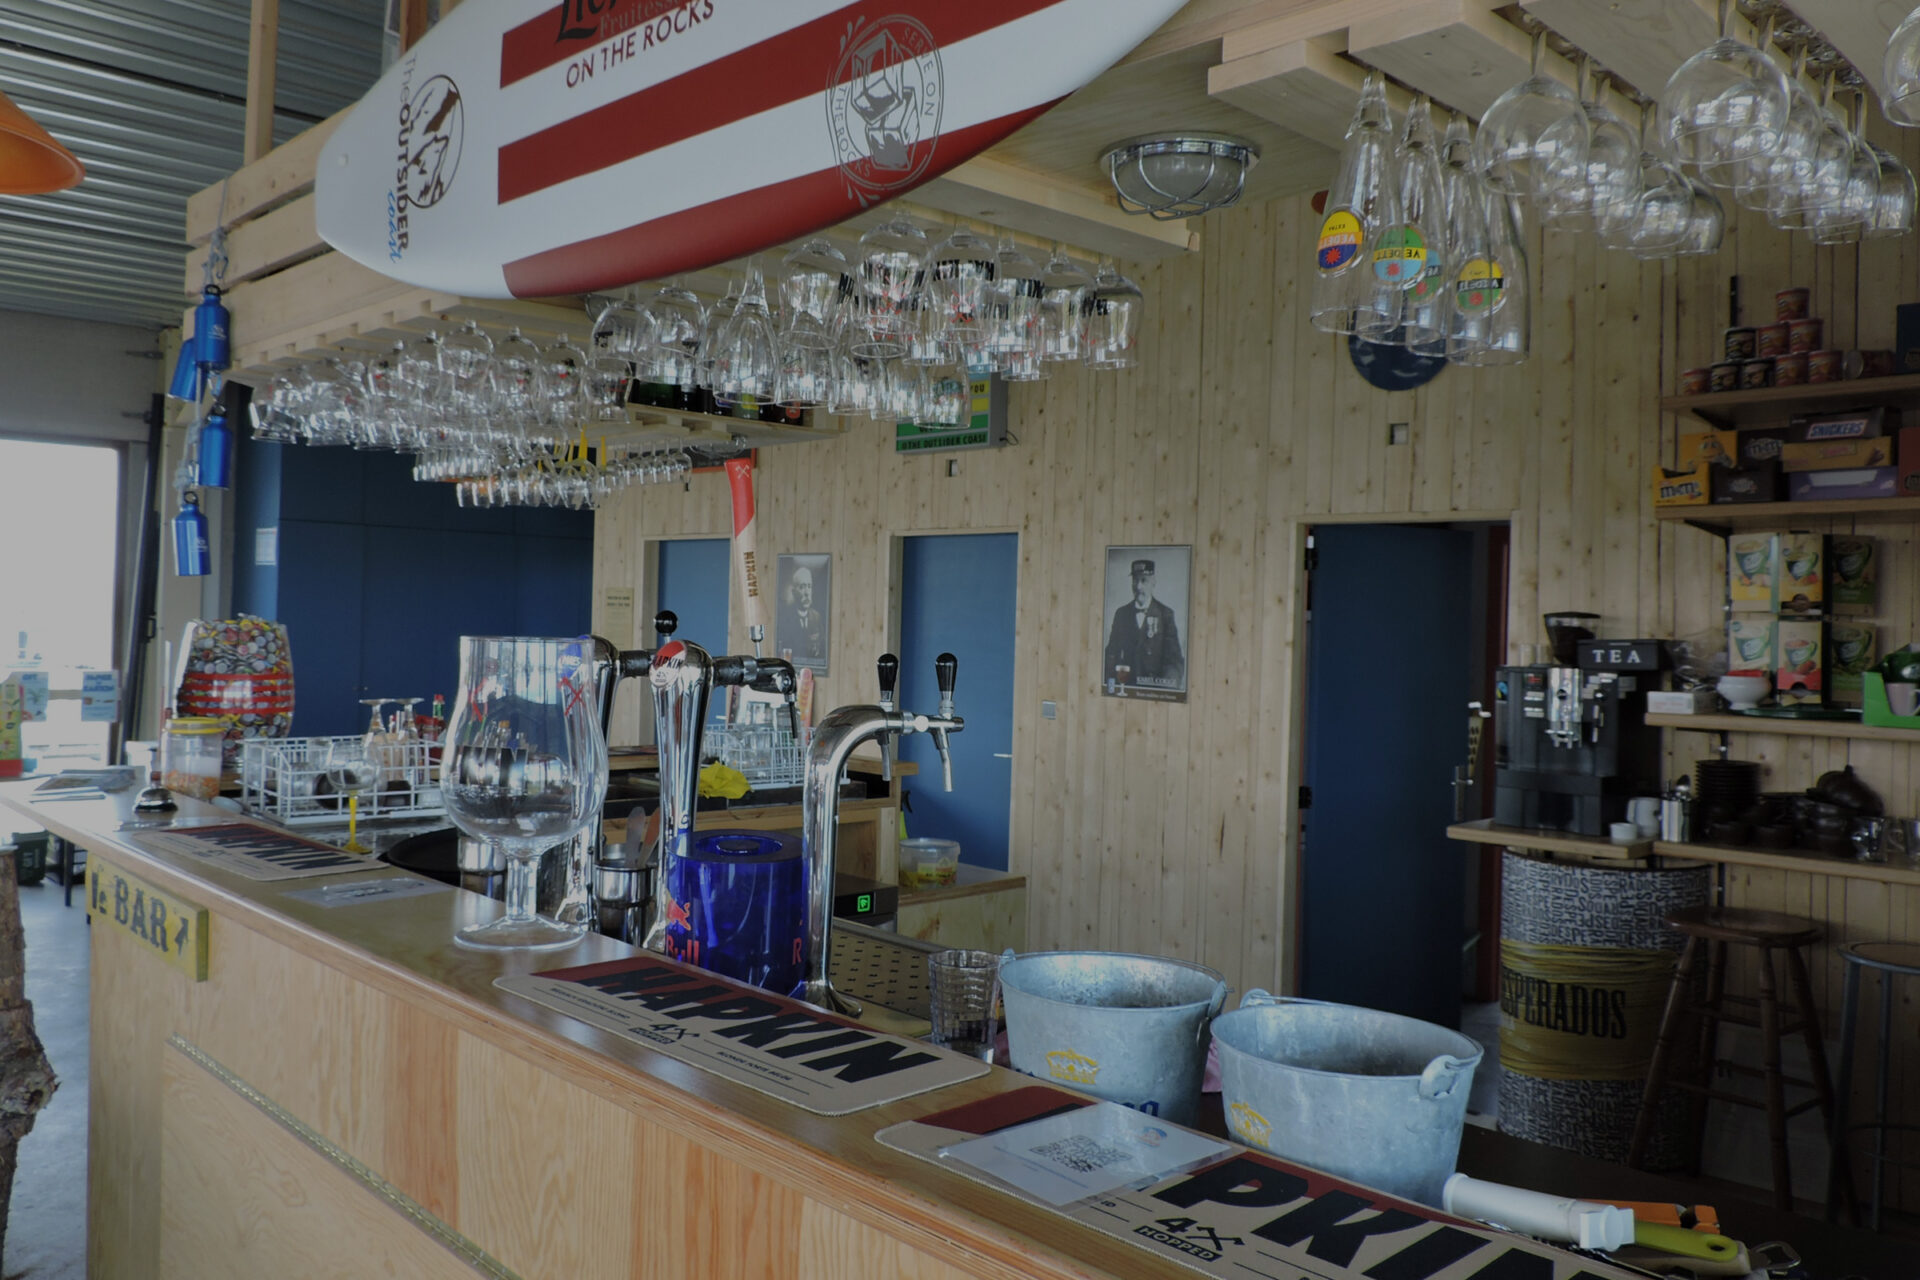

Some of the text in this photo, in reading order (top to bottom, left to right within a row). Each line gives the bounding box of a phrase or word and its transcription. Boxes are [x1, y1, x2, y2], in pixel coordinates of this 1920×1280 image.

[566, 54, 595, 88] ON
[601, 32, 637, 71] THE
[643, 0, 714, 51] ROCKS
[903, 26, 937, 117] SERVE ON
[397, 103, 411, 250] OUTSIDER
[834, 87, 872, 178] THE ROCKS
[1809, 421, 1865, 438] SNICKERS
[1592, 649, 1641, 663] TEA
[92, 871, 169, 953] le BAR
[575, 966, 943, 1084] HAPKIN
[1136, 1226, 1221, 1261] HOPPED
